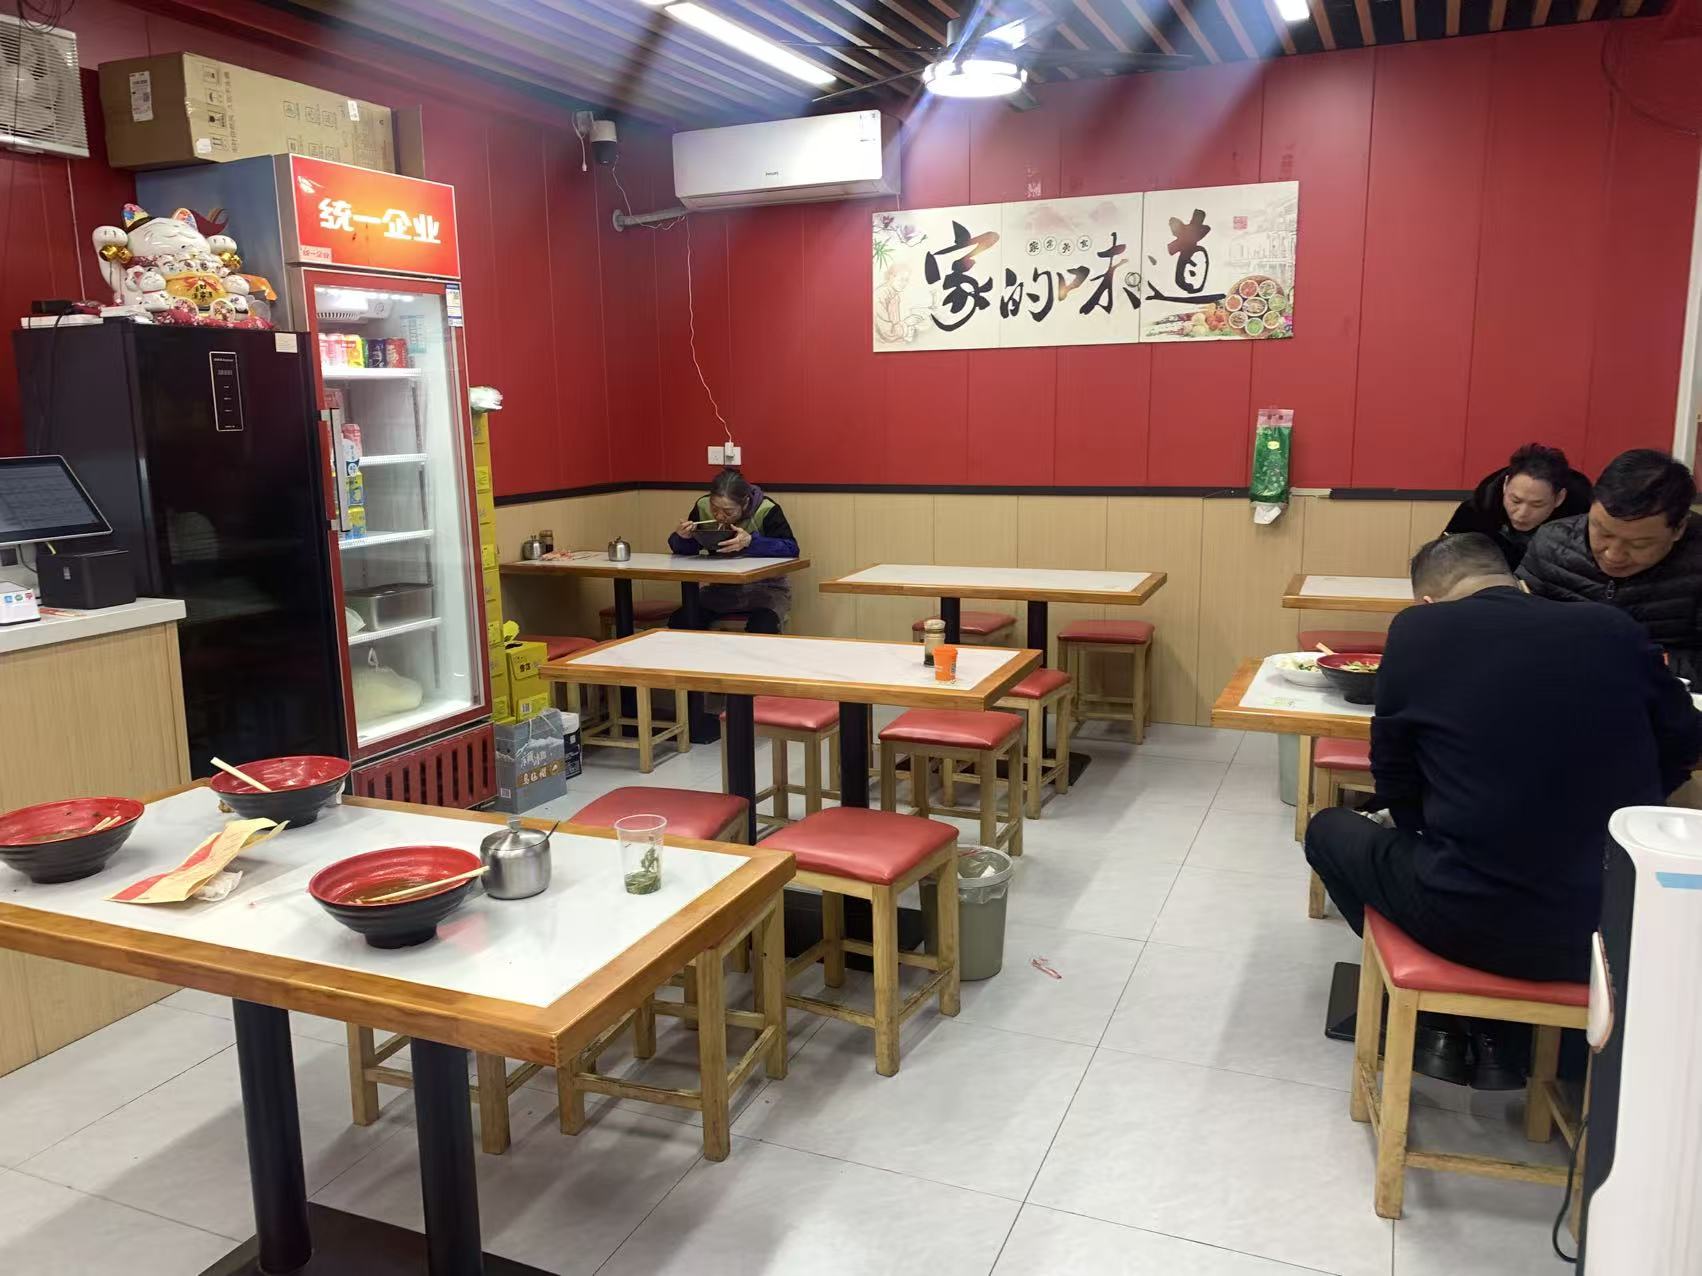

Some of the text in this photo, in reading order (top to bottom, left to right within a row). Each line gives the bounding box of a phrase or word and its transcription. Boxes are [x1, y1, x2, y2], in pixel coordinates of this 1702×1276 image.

[318, 197, 441, 244] 统一企业
[924, 208, 1227, 332] 家的味道
